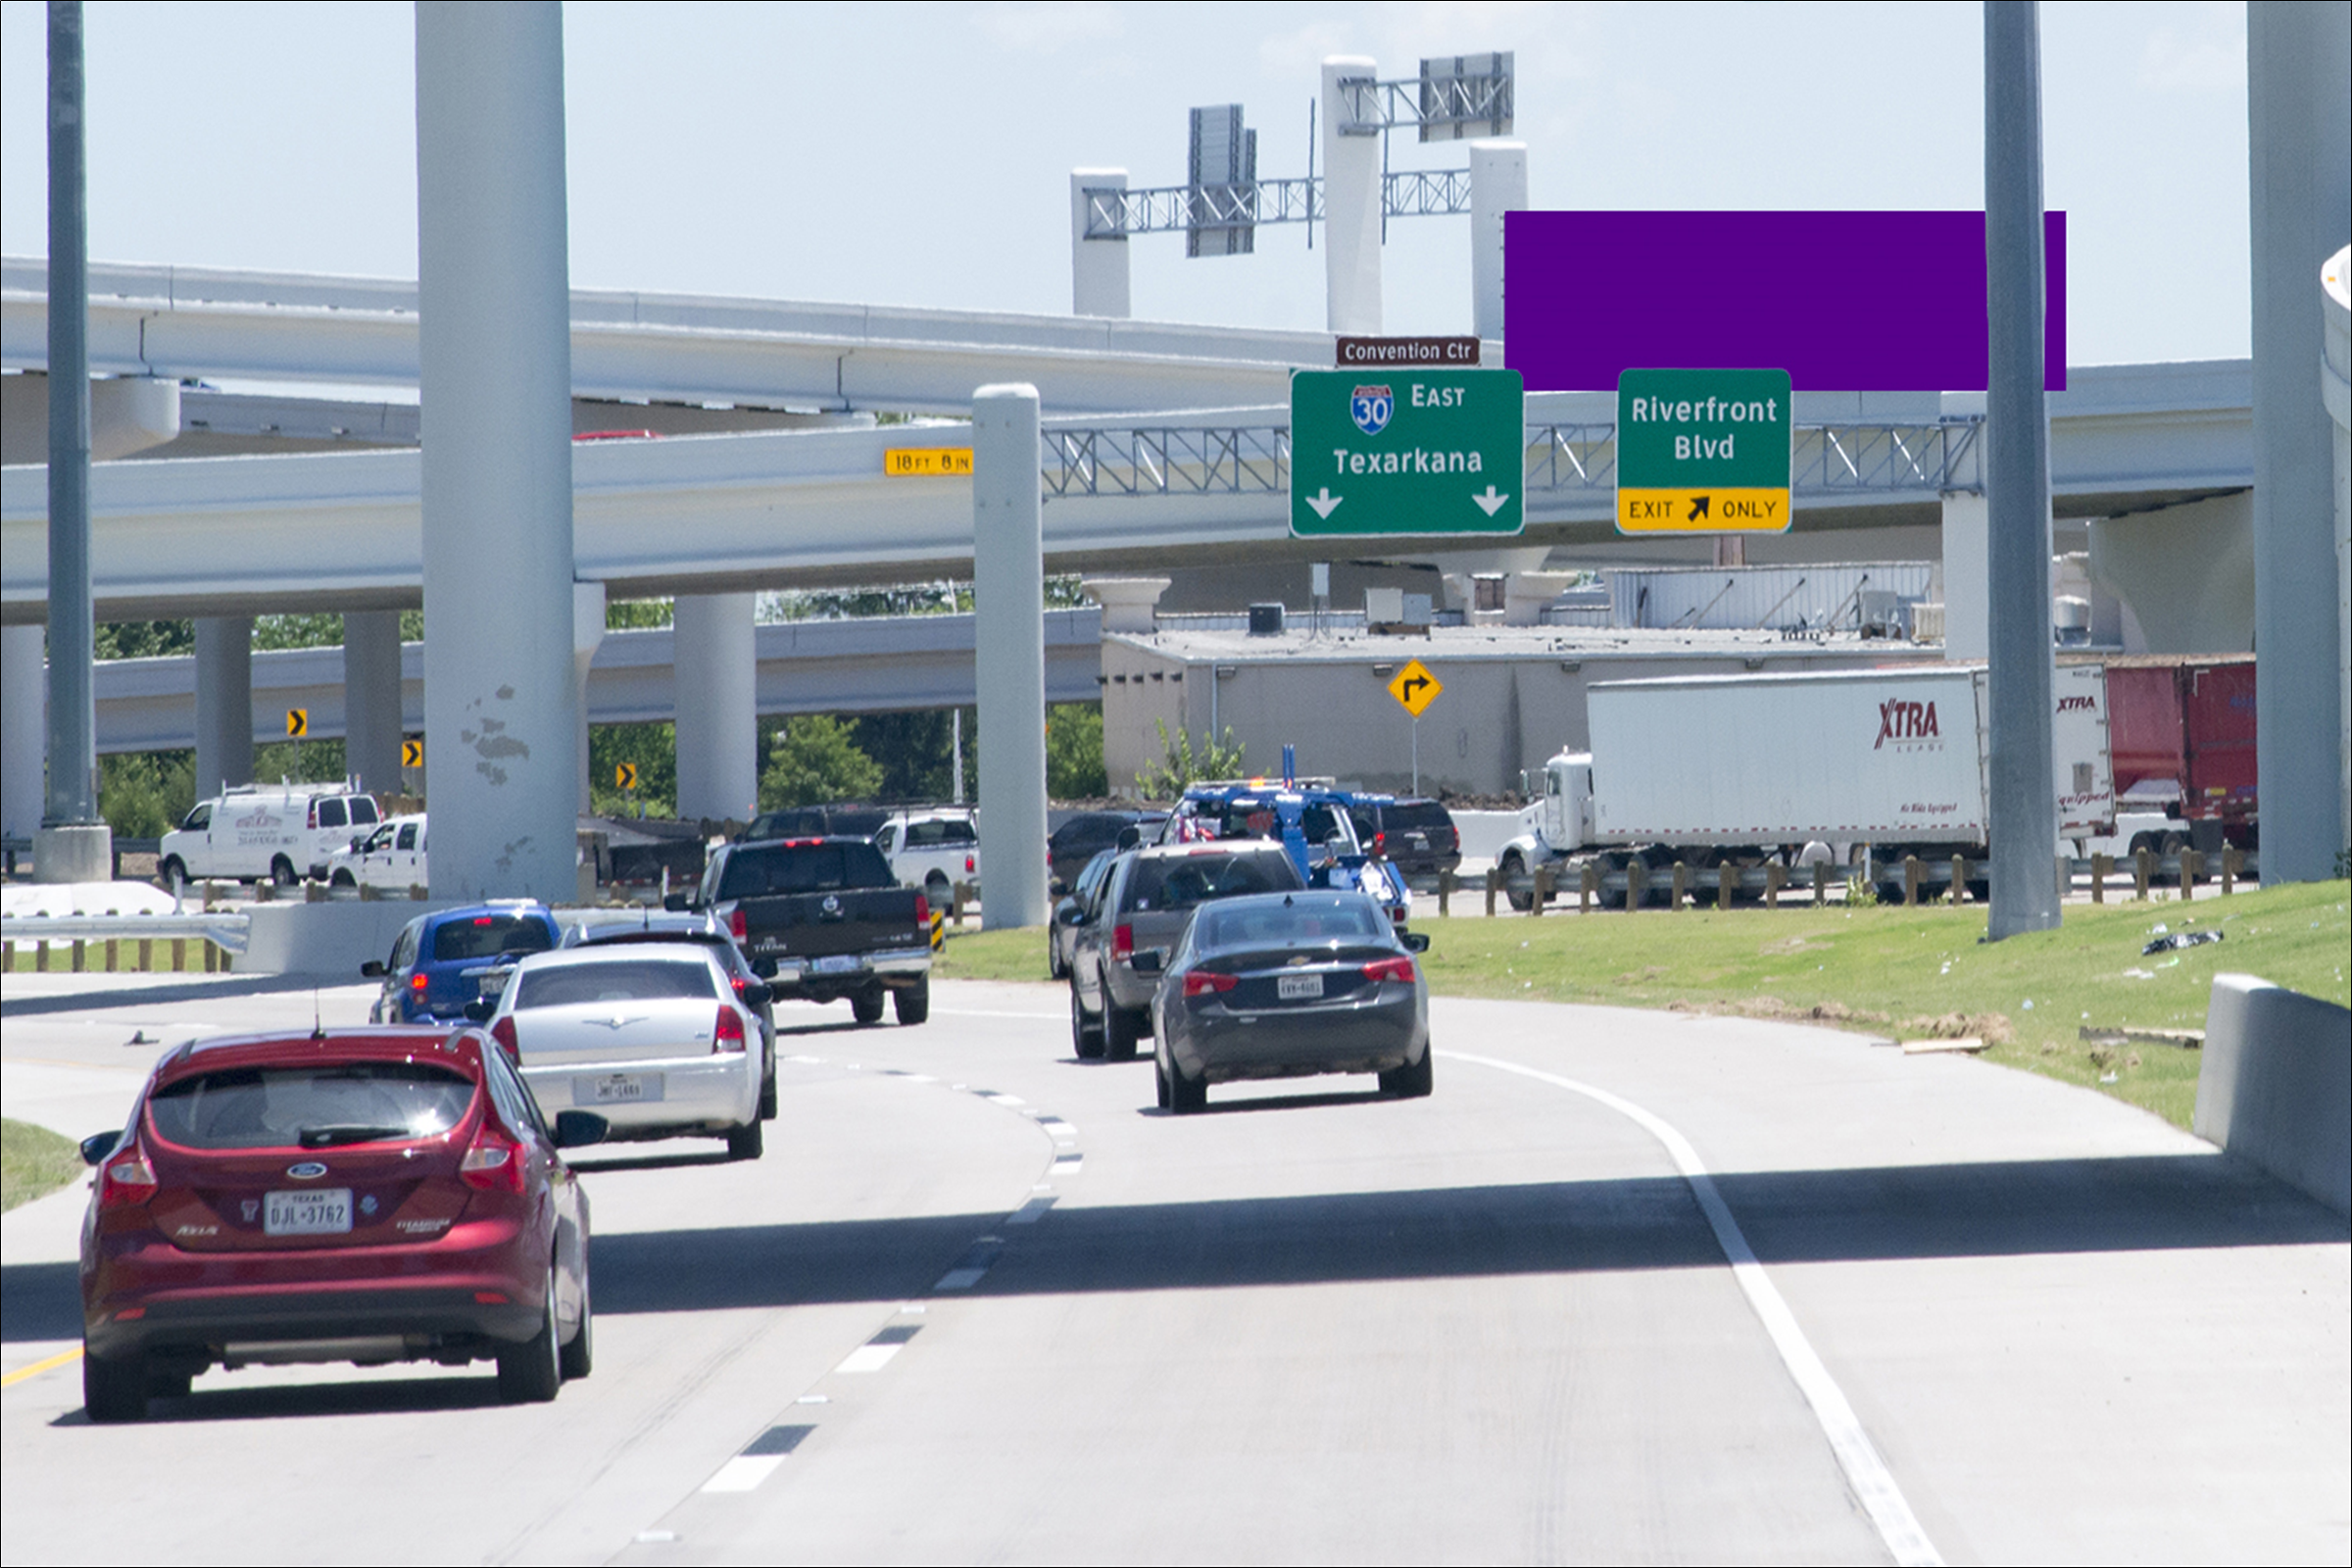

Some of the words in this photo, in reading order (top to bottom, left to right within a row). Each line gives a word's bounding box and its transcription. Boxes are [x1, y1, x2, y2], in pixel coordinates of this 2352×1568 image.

[1345, 342, 1441, 361] Convention
[1446, 342, 1471, 360] Ctr
[1356, 397, 1389, 426] 30
[1632, 395, 1778, 422] Riverfront
[1674, 433, 1735, 460] Blvd
[1333, 447, 1483, 474] Texarkana
[1629, 500, 1674, 519] EXIT
[1722, 500, 1778, 518] ONLY
[2056, 695, 2095, 714] XTRA
[1874, 697, 1939, 750] XTRA
[293, 1195, 324, 1203] TEXAS
